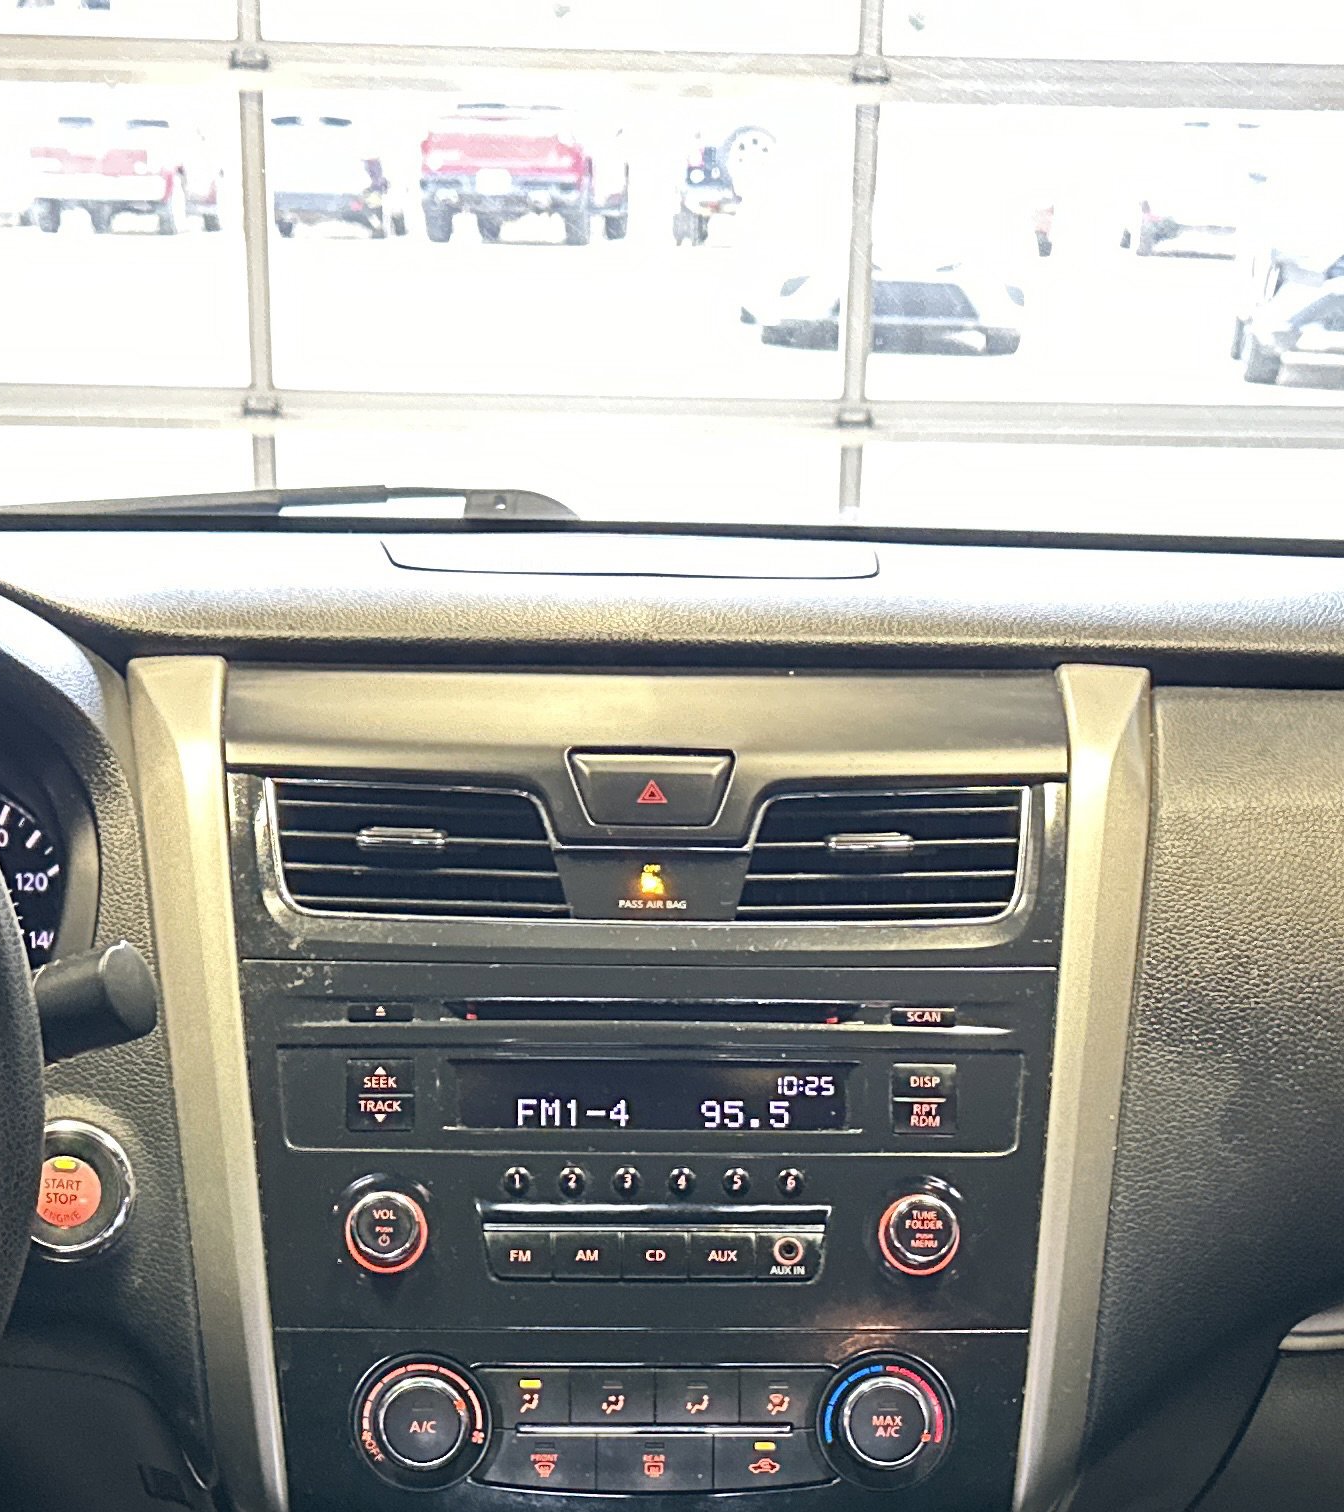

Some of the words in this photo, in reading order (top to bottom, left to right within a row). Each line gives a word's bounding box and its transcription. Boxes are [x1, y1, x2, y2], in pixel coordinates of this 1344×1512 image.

[15, 872, 49, 892] 120
[618, 900, 643, 909] PASS
[646, 900, 664, 909] AIR
[666, 900, 687, 909] BAG
[907, 1011, 942, 1023] SCAN
[363, 1076, 397, 1089] SEEK
[777, 1076, 835, 1096] 10:25
[909, 1075, 941, 1088] DISP
[358, 1100, 402, 1113] TRACK
[517, 1098, 630, 1128] FM1-4
[700, 1100, 790, 1128] 95.5
[912, 1103, 938, 1116] RPT
[910, 1115, 941, 1128] RDM
[44, 1178, 82, 1191] START
[513, 1174, 521, 1189] 1
[567, 1174, 577, 1189] 2
[623, 1173, 632, 1189] 3
[676, 1174, 687, 1190] 4
[732, 1174, 743, 1190] 5
[786, 1175, 796, 1191] 6
[46, 1192, 78, 1205] STOP
[372, 1209, 397, 1220] VOL
[911, 1210, 937, 1220] TUNE
[905, 1219, 944, 1229] FOLDER
[910, 1240, 938, 1248] MENU
[509, 1250, 531, 1262] FM
[575, 1249, 599, 1262] AM
[645, 1249, 666, 1262] CD
[707, 1250, 738, 1262] AUX
[769, 1265, 792, 1275] AUX
[793, 1265, 805, 1275] IN
[409, 1420, 437, 1434] A/C
[872, 1415, 903, 1427] MAX
[875, 1426, 900, 1438] A/C
